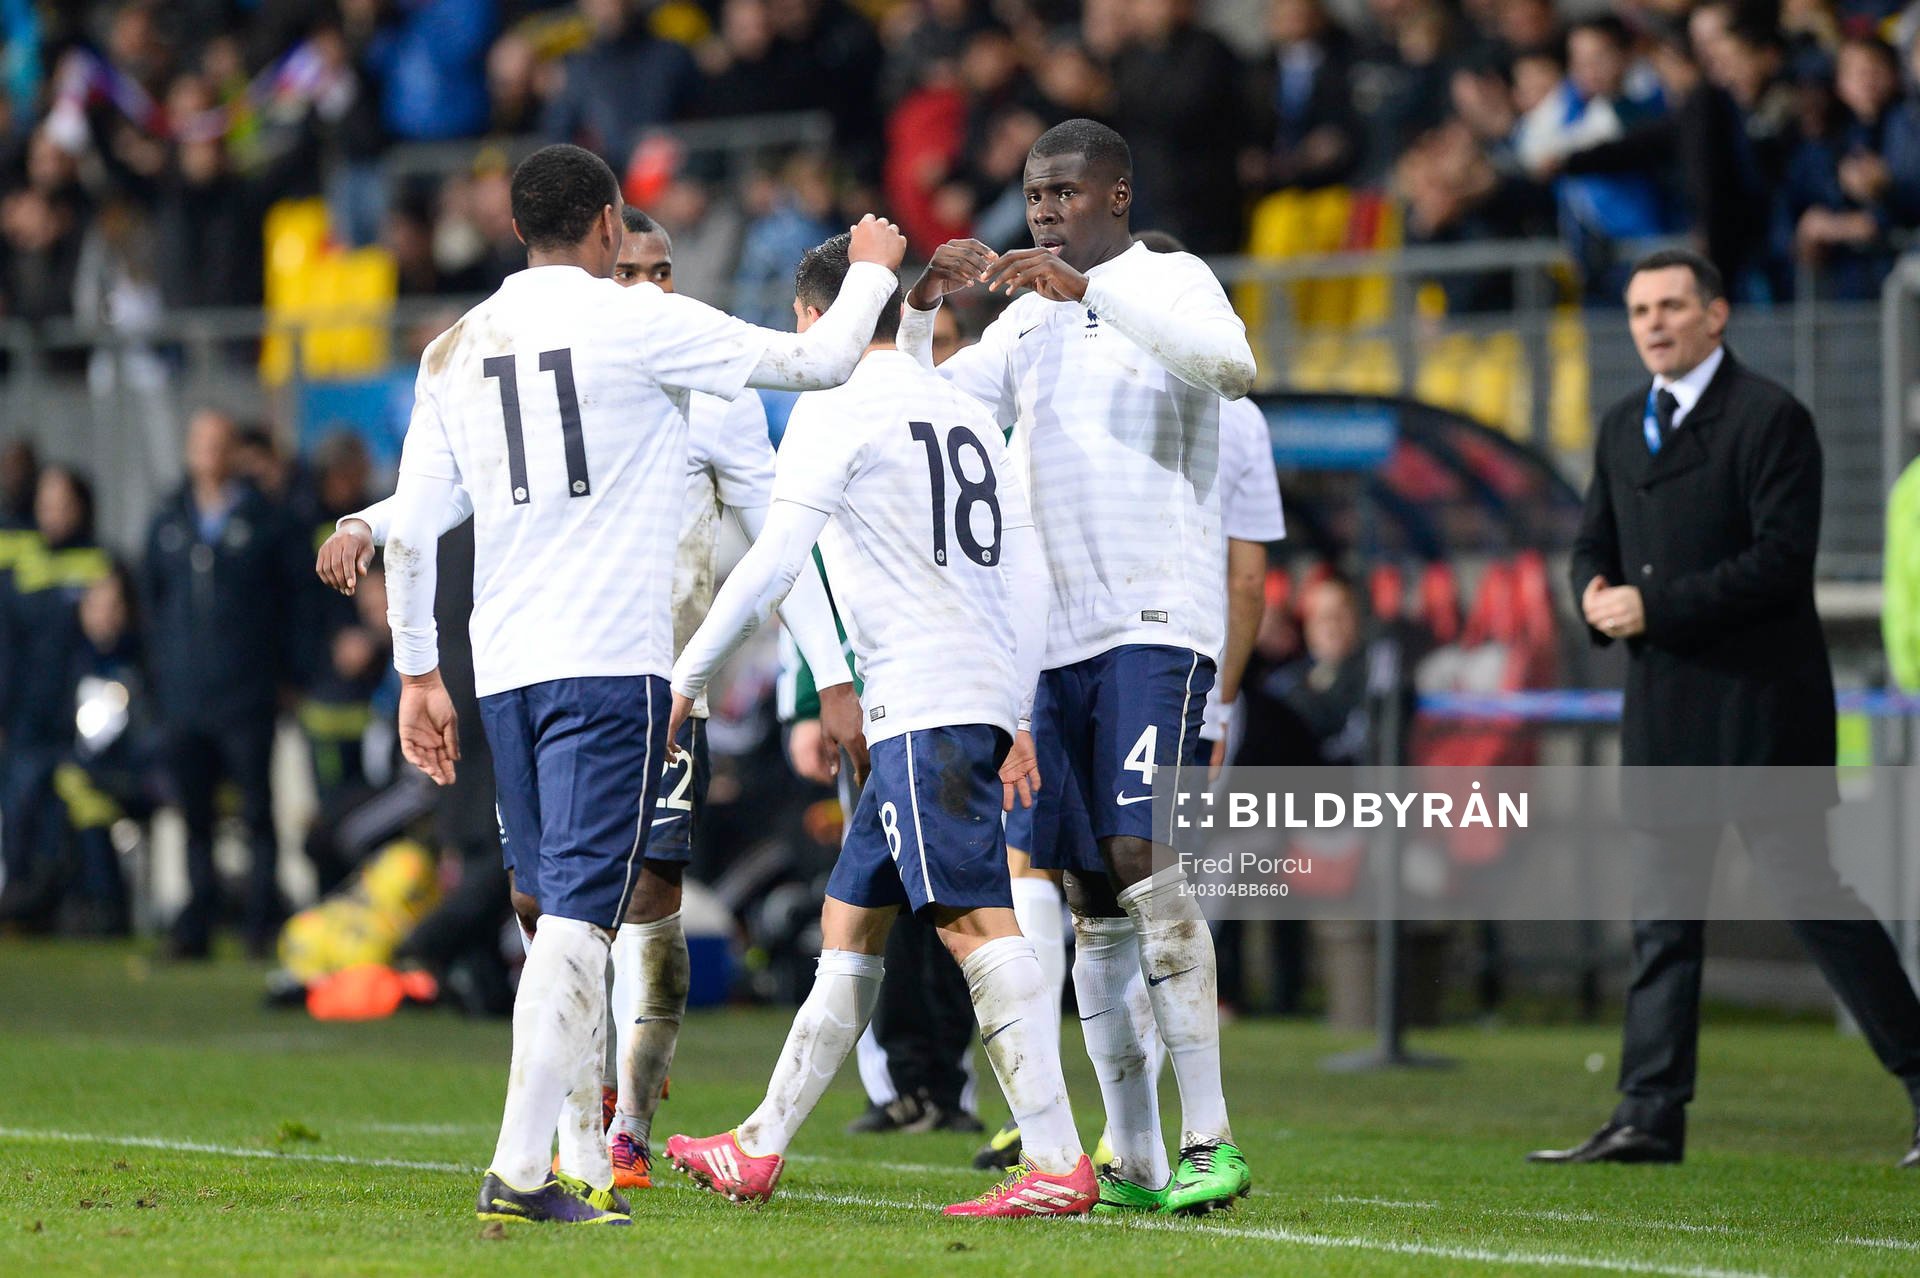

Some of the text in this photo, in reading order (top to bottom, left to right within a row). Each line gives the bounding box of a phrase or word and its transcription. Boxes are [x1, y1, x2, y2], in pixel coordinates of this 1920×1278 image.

[483, 347, 591, 505] 11
[908, 421, 1002, 567] 18
[1123, 724, 1159, 785] 4
